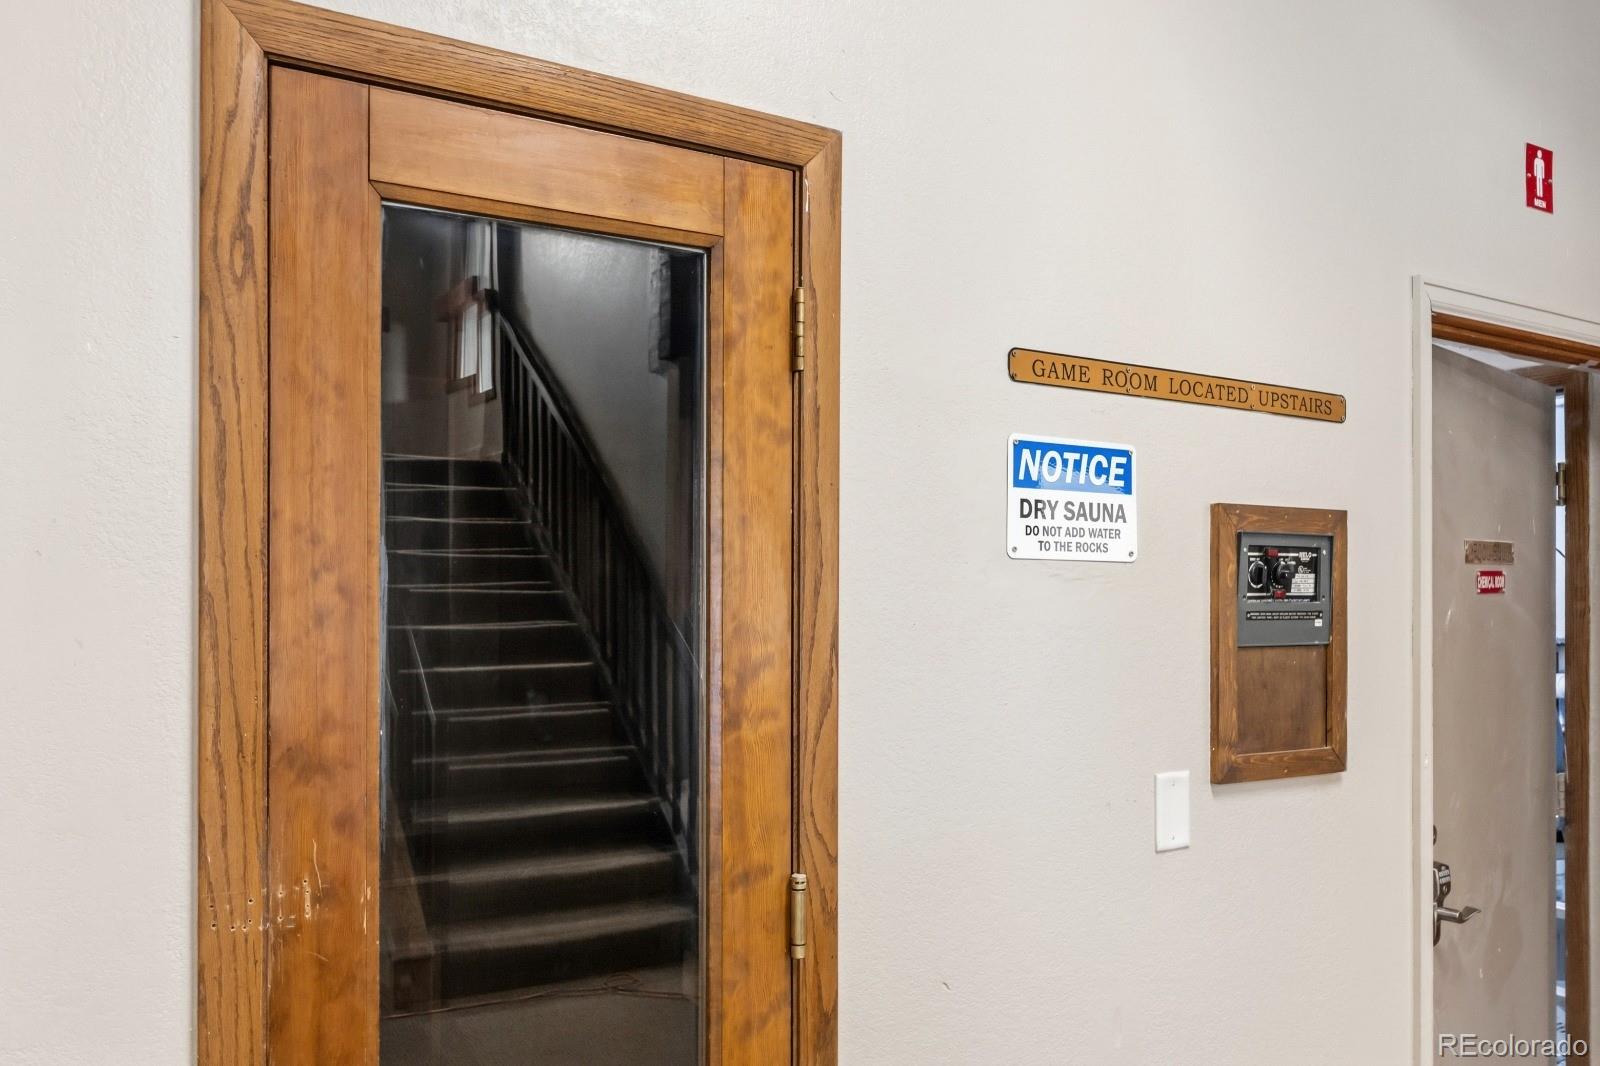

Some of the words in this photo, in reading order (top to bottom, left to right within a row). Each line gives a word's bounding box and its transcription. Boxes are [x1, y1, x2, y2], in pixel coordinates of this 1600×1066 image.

[1031, 358, 1091, 383] GAME
[1102, 368, 1158, 392] ROOM
[1169, 378, 1249, 404] LOCATED
[1259, 390, 1333, 415] UPSTAIRS
[1018, 448, 1127, 486] NOTICE
[1019, 498, 1059, 520] DRY
[1063, 500, 1127, 523] SAUNA
[1025, 524, 1040, 536] DO
[1042, 525, 1062, 537] NOT
[1064, 526, 1085, 538] ADD
[1088, 527, 1121, 539] WATER
[1038, 540, 1051, 552] TO
[1053, 541, 1073, 552] THE
[1075, 542, 1109, 553] ROCKS
